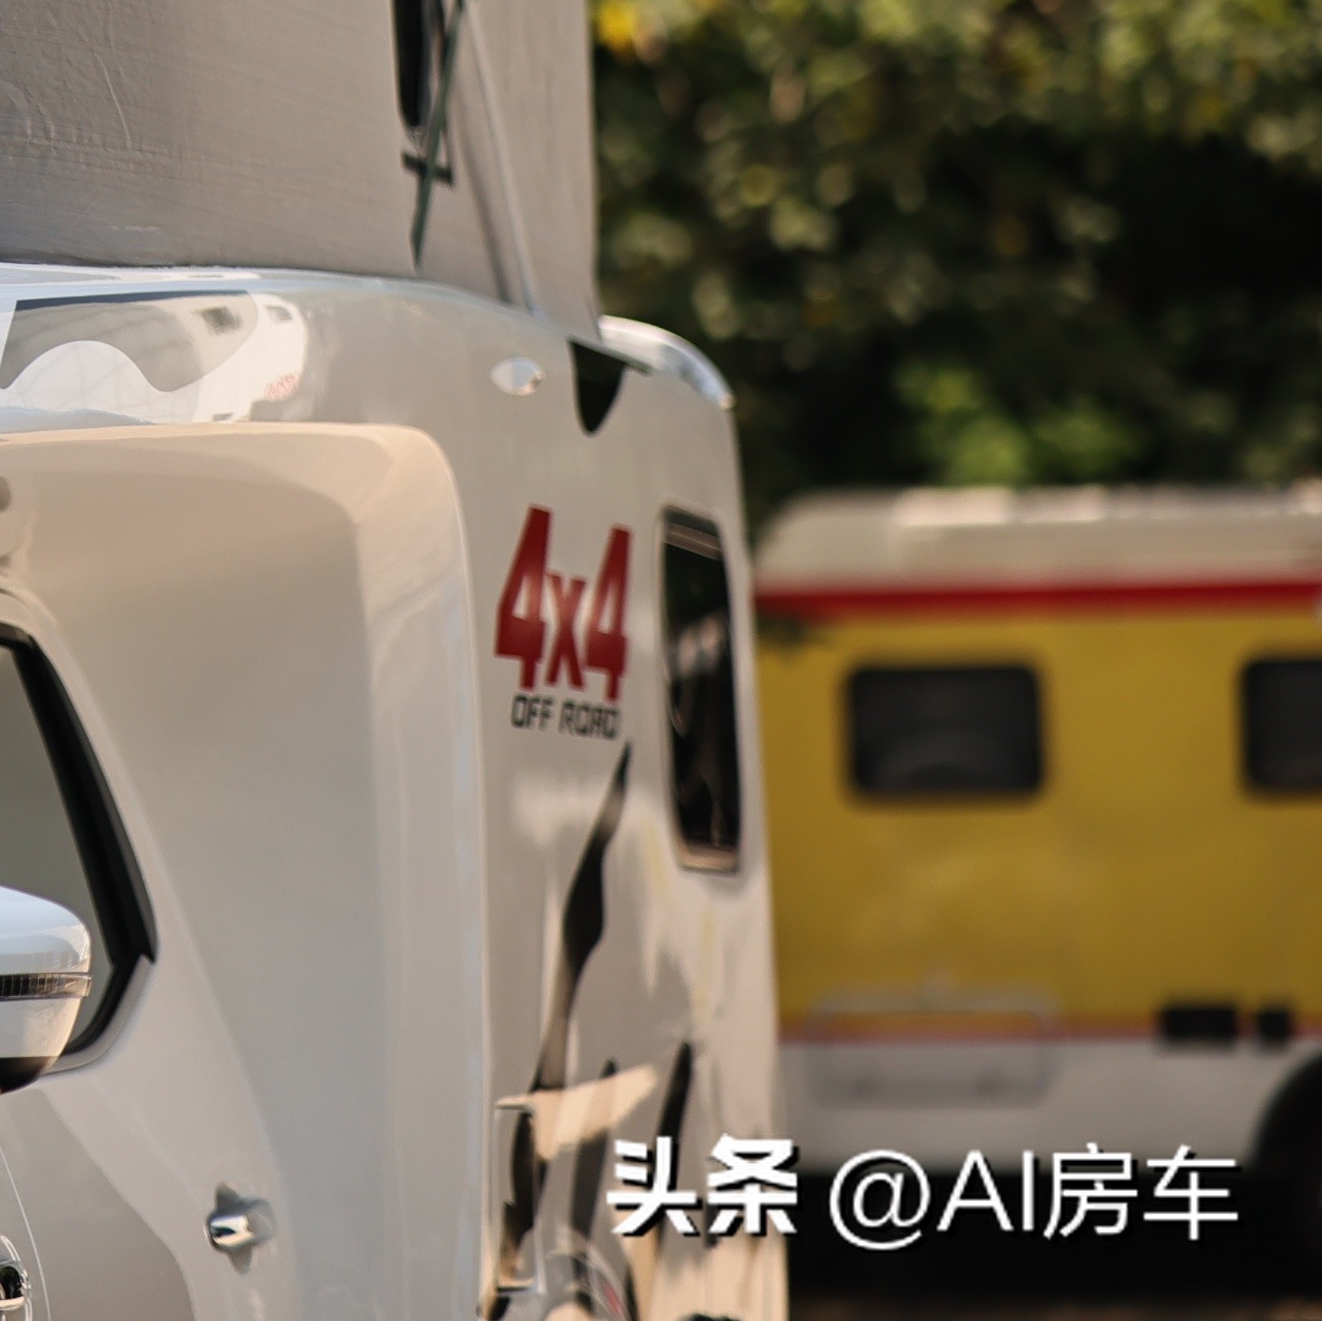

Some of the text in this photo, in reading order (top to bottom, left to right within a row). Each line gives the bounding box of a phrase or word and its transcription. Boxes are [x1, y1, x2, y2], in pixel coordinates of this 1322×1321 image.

[494, 503, 630, 702] 4x4
[511, 693, 621, 740] OFF ROAD
